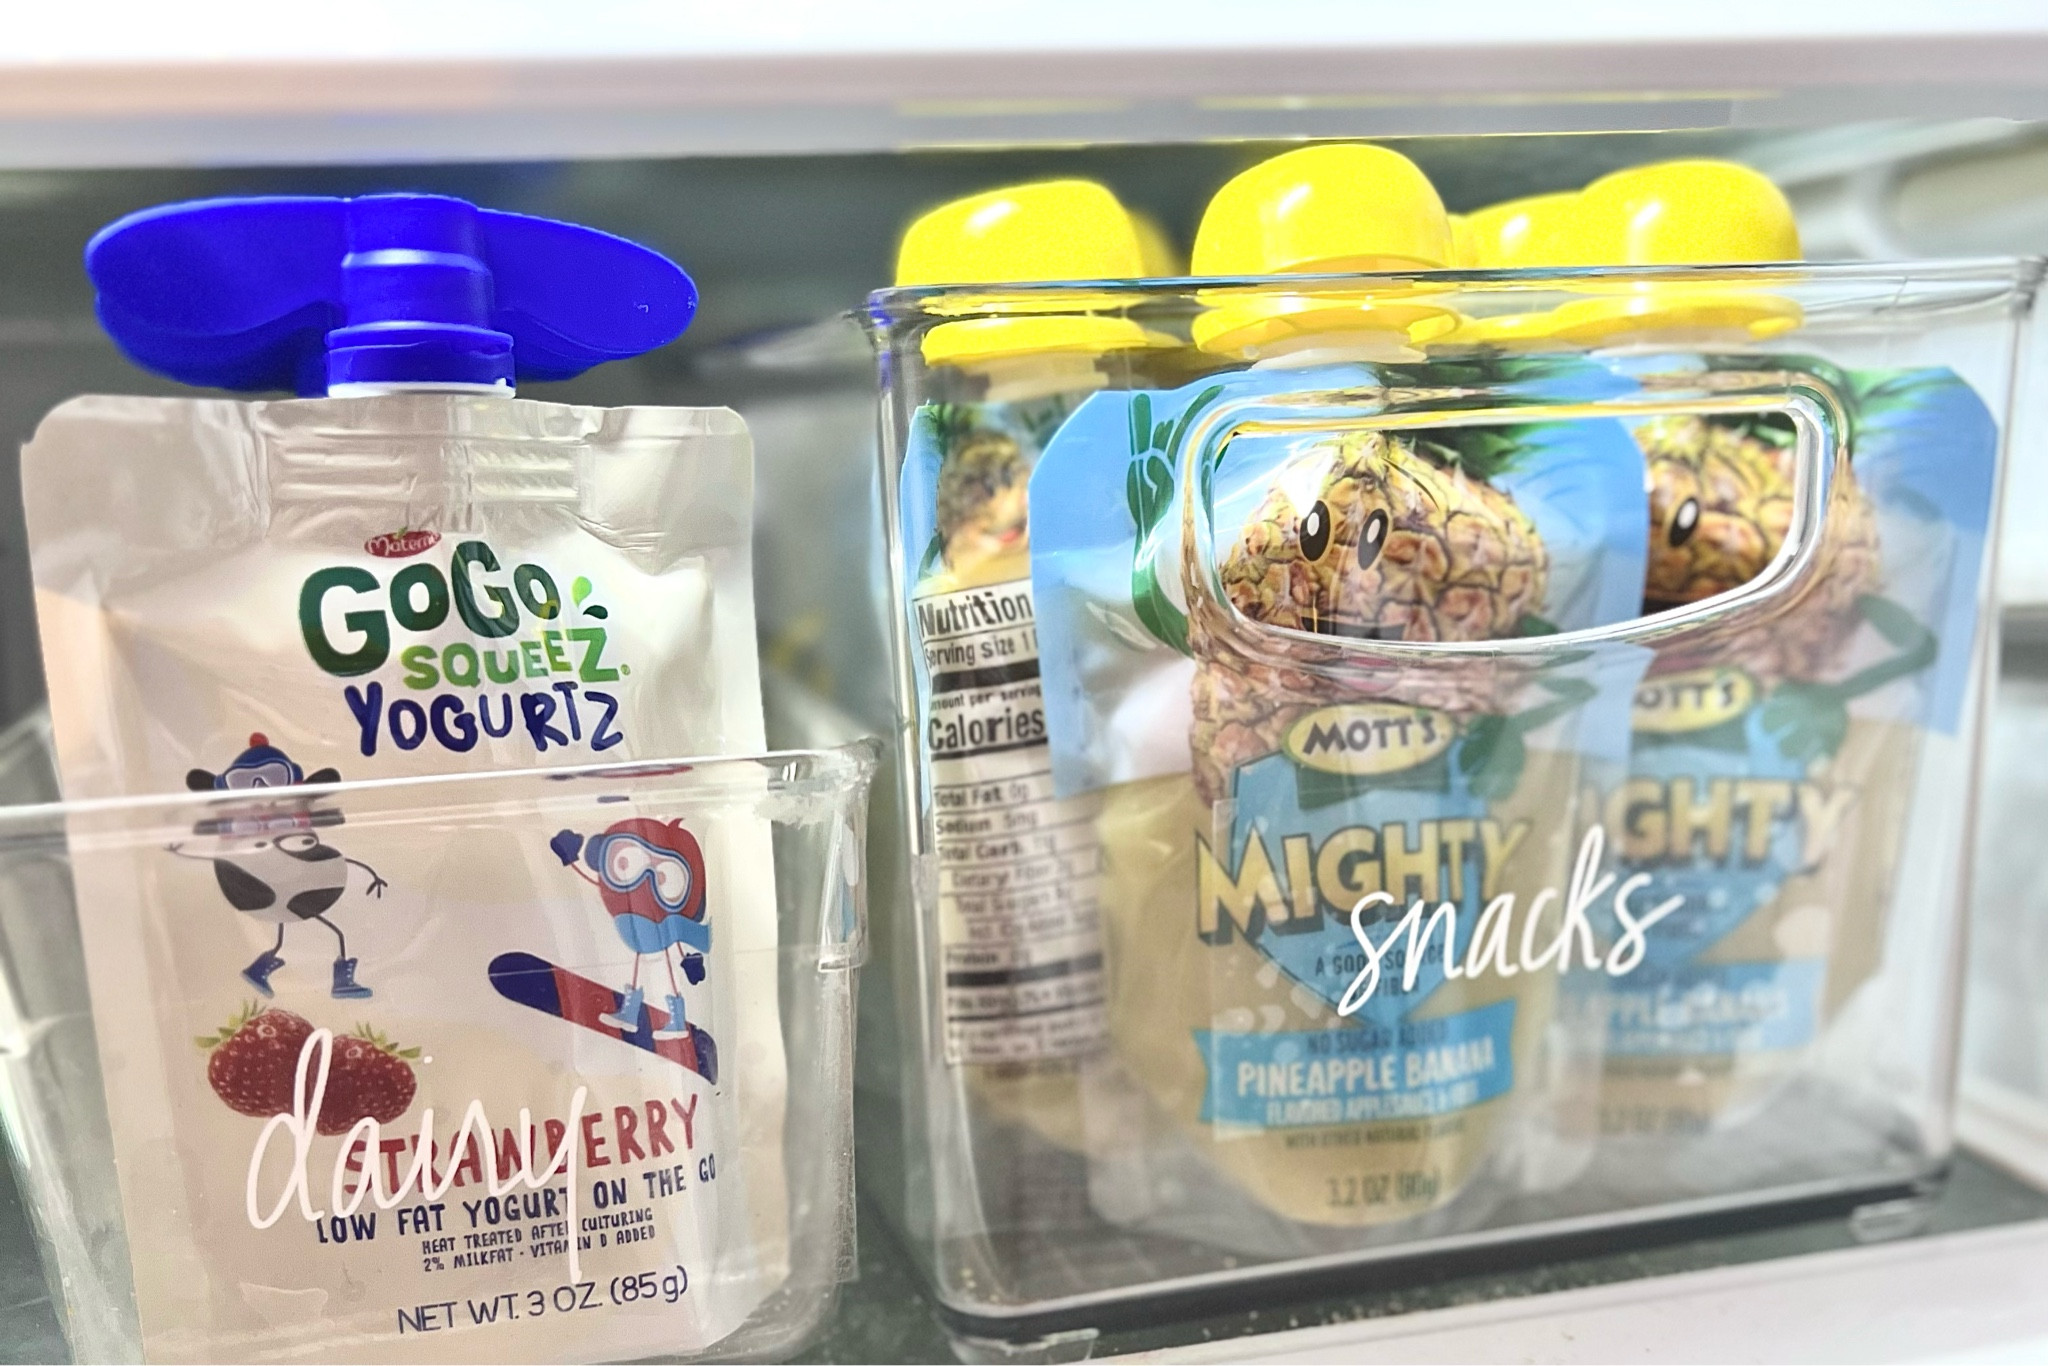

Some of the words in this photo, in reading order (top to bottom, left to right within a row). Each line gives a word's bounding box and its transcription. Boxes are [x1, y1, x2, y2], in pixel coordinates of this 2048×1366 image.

[917, 591, 1033, 638] Nutrition
[980, 634, 1016, 659] size
[930, 693, 966, 711] mount
[969, 692, 994, 709] per
[1634, 678, 1737, 710] OTT'S
[344, 681, 624, 757] YOGURTZ
[928, 706, 1045, 752] Calories
[1302, 715, 1438, 755] MOTT'S
[971, 785, 1003, 806] Fat
[1605, 774, 1858, 874] GHTY
[1194, 817, 1533, 946] MIGHTY
[1336, 824, 1686, 1018] snacks
[1332, 953, 1372, 976] GOO
[1384, 945, 1446, 971] SOCE
[1237, 1053, 1400, 1097] PINEAPPLE
[1404, 1035, 1495, 1089] BANANA
[246, 1028, 588, 1284] dairy
[316, 1212, 377, 1244] LOW
[397, 1203, 446, 1236] FAT
[592, 1177, 628, 1210] ON
[642, 1164, 687, 1199] THE
[698, 1152, 716, 1183] GO
[421, 1237, 456, 1256] HEAT
[463, 1222, 522, 1250] TREATED
[581, 1207, 653, 1232] CULTURING
[423, 1257, 445, 1273] 2%
[452, 1247, 514, 1270] MILKFAT
[599, 1232, 608, 1248] D
[616, 1224, 656, 1245] ADDED
[397, 1301, 458, 1334] NET
[467, 1293, 520, 1325] WT.
[526, 1289, 546, 1317] 3
[553, 1281, 603, 1313] OZ.
